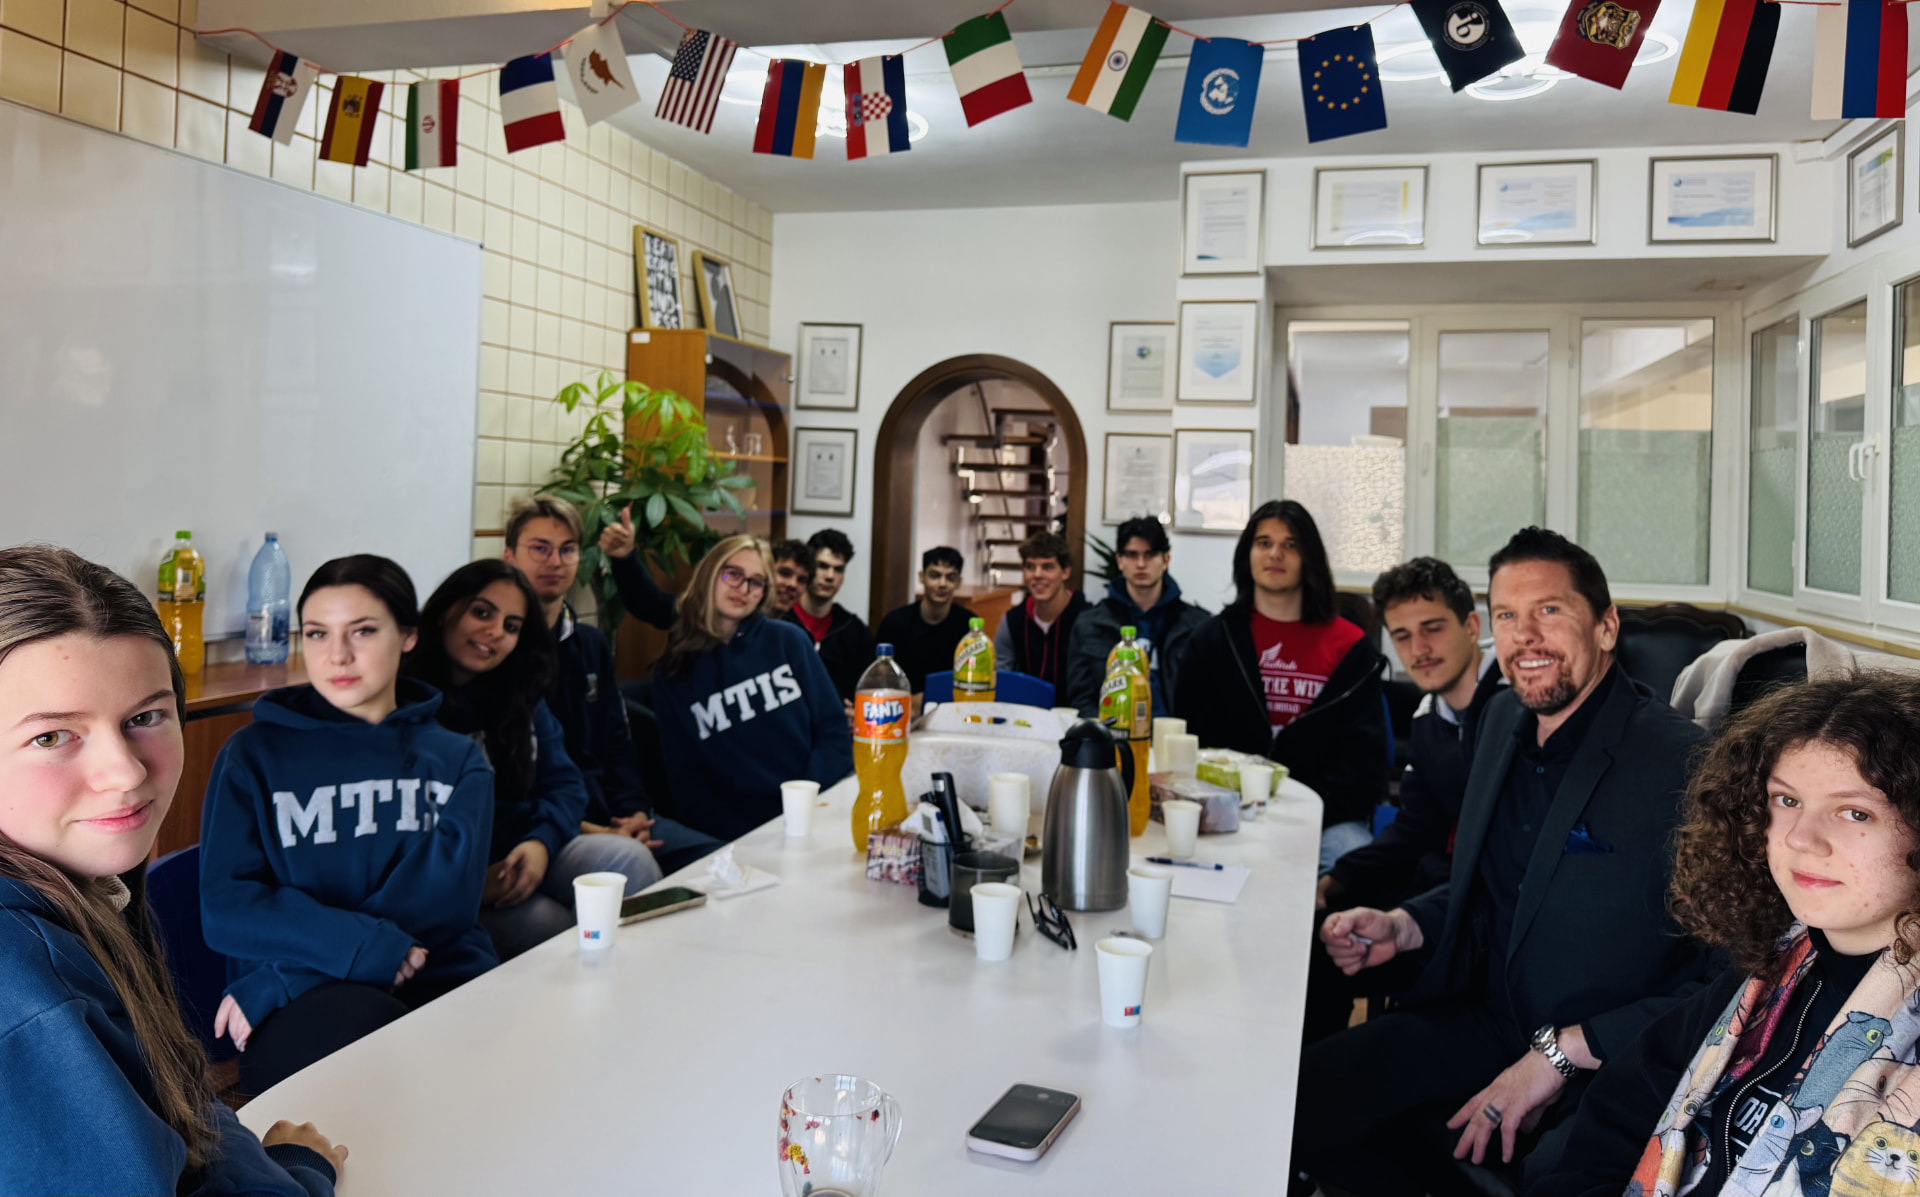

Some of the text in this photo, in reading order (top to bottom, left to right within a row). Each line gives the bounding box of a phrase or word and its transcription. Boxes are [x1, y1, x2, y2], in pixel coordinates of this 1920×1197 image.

[1261, 676, 1290, 695] THE
[690, 663, 802, 740] MTIS
[863, 700, 904, 719] FANTA
